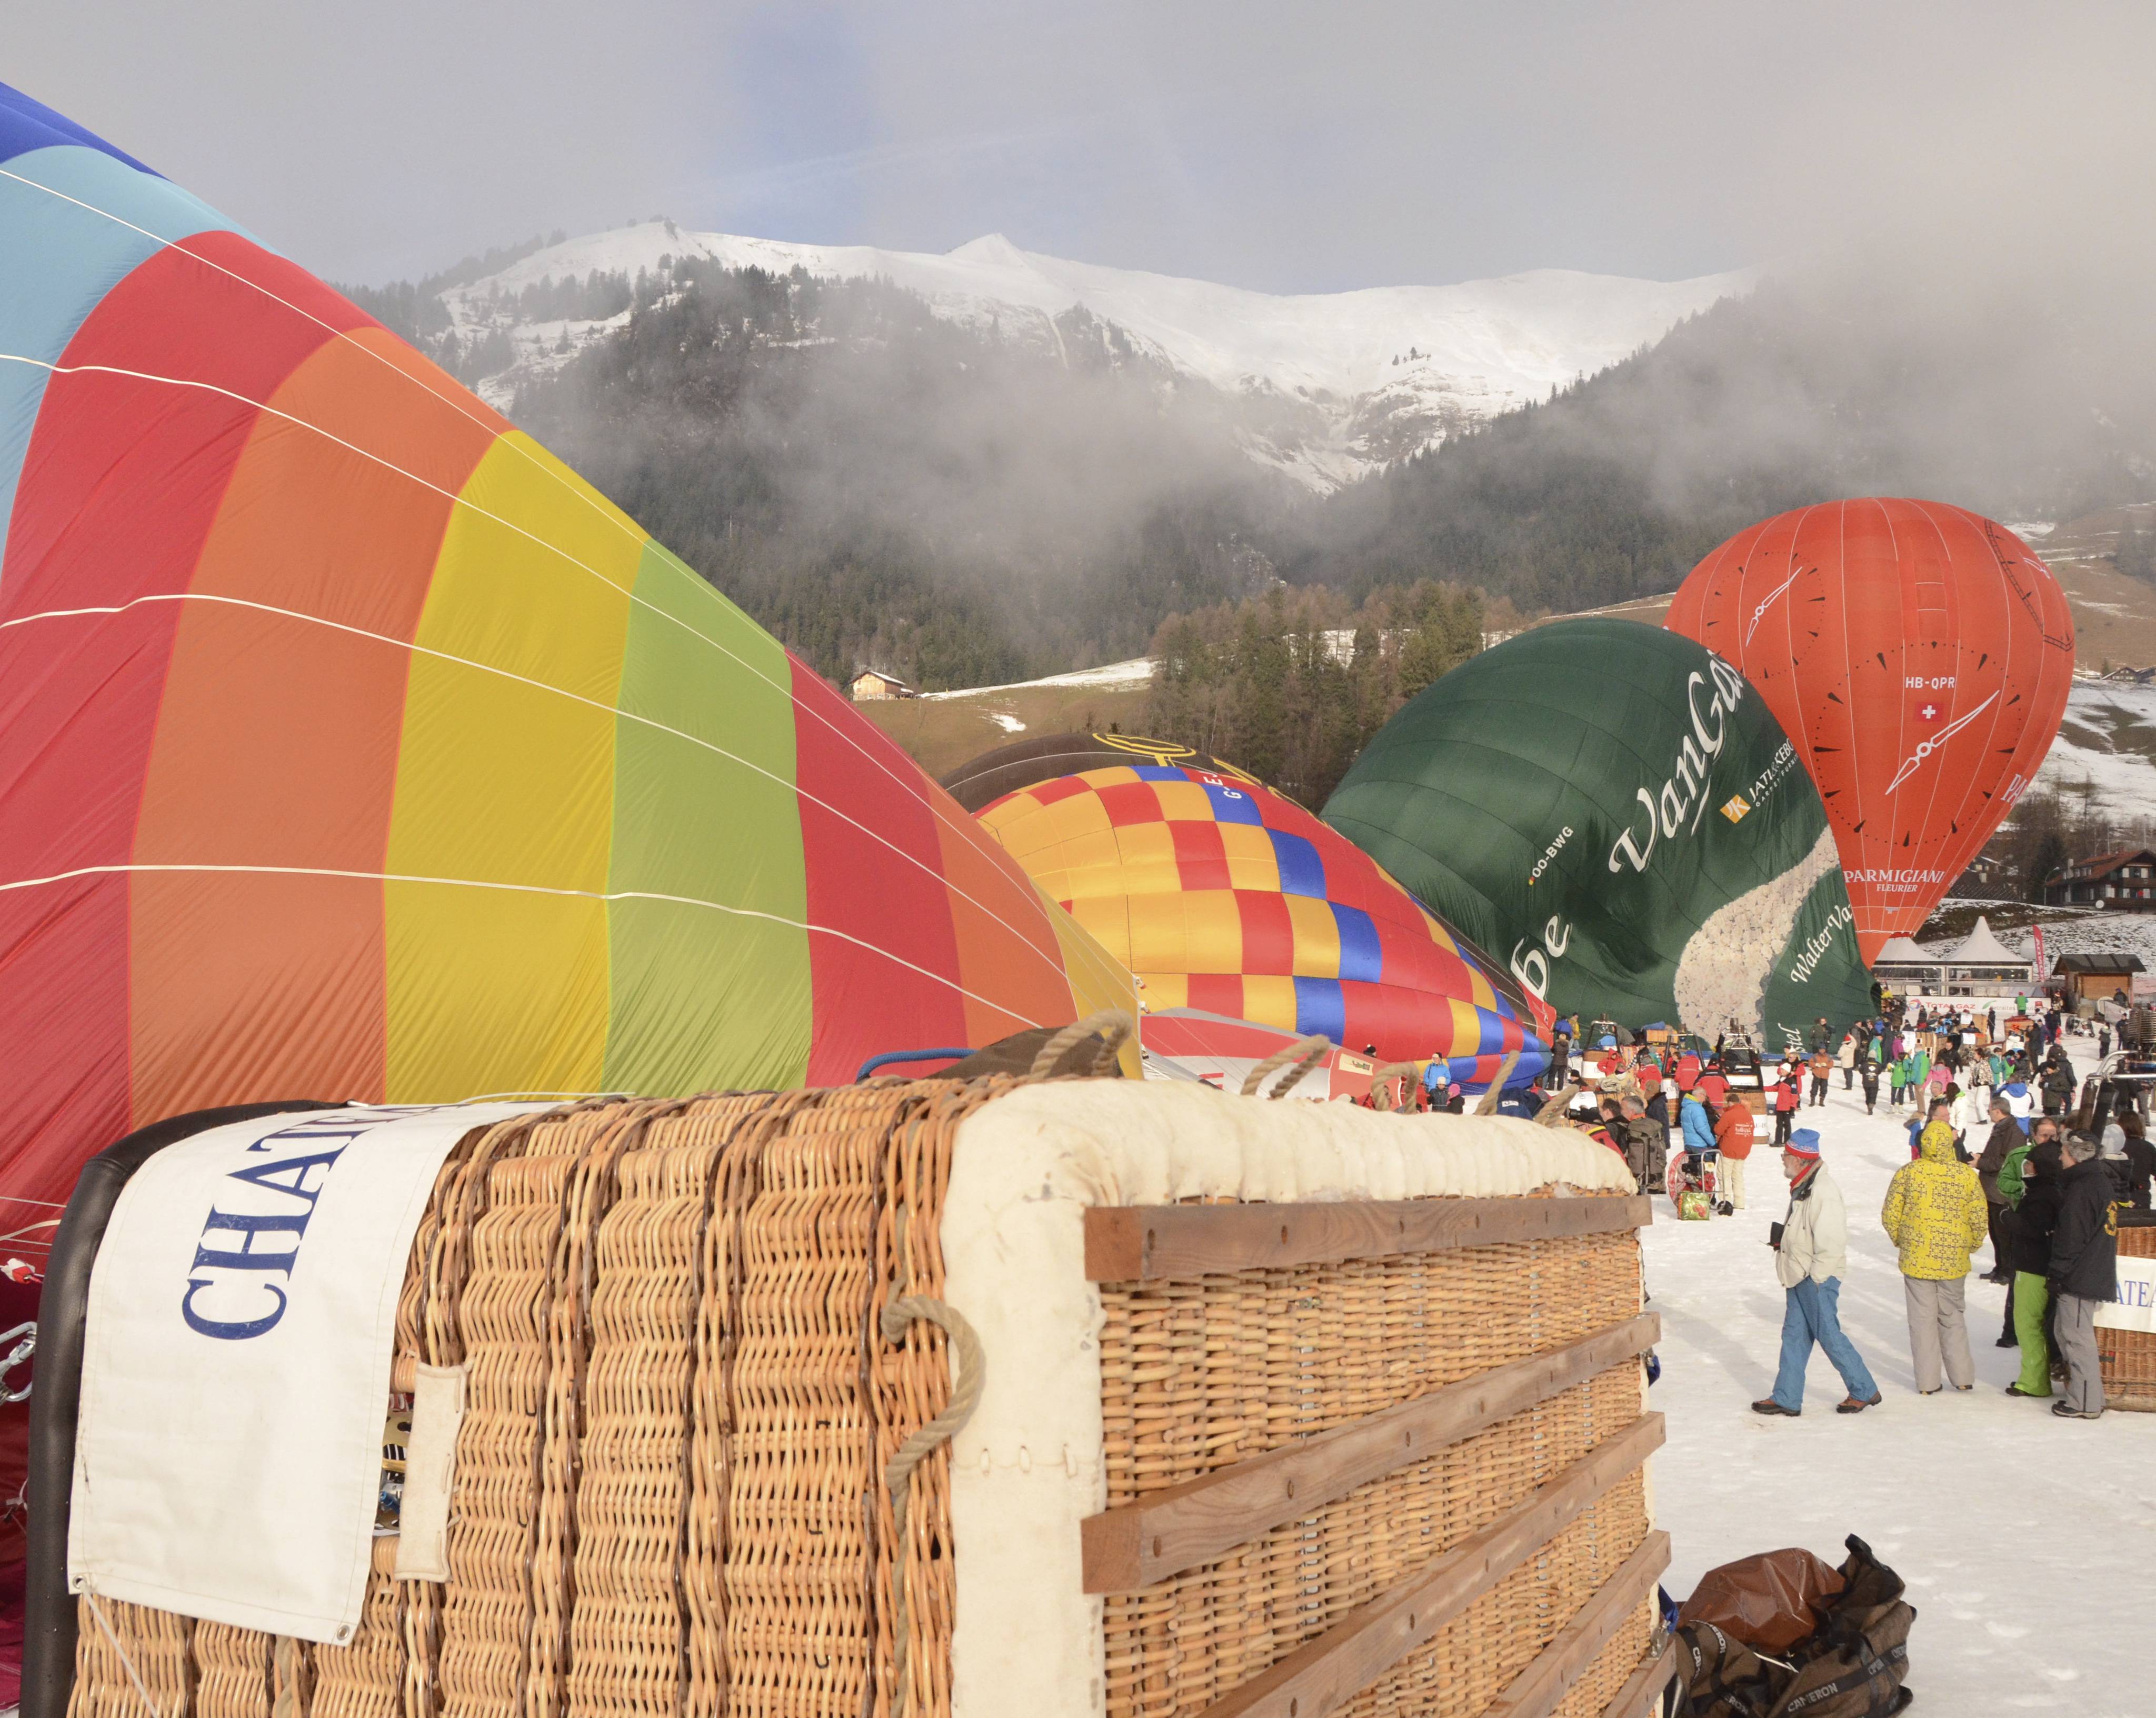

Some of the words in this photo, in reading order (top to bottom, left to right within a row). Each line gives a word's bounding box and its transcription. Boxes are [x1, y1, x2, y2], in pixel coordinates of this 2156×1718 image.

[1905, 676, 1955, 690] HB-QPR
[1532, 826, 1573, 878] OO-BWG
[1843, 869, 1945, 884] PARMIGIANI
[1876, 883, 1918, 892] FLEURIER
[1791, 925, 1833, 983] Walter
[2116, 1280, 2156, 1308] ATE
[1788, 1682, 1838, 1713] CAMERON
